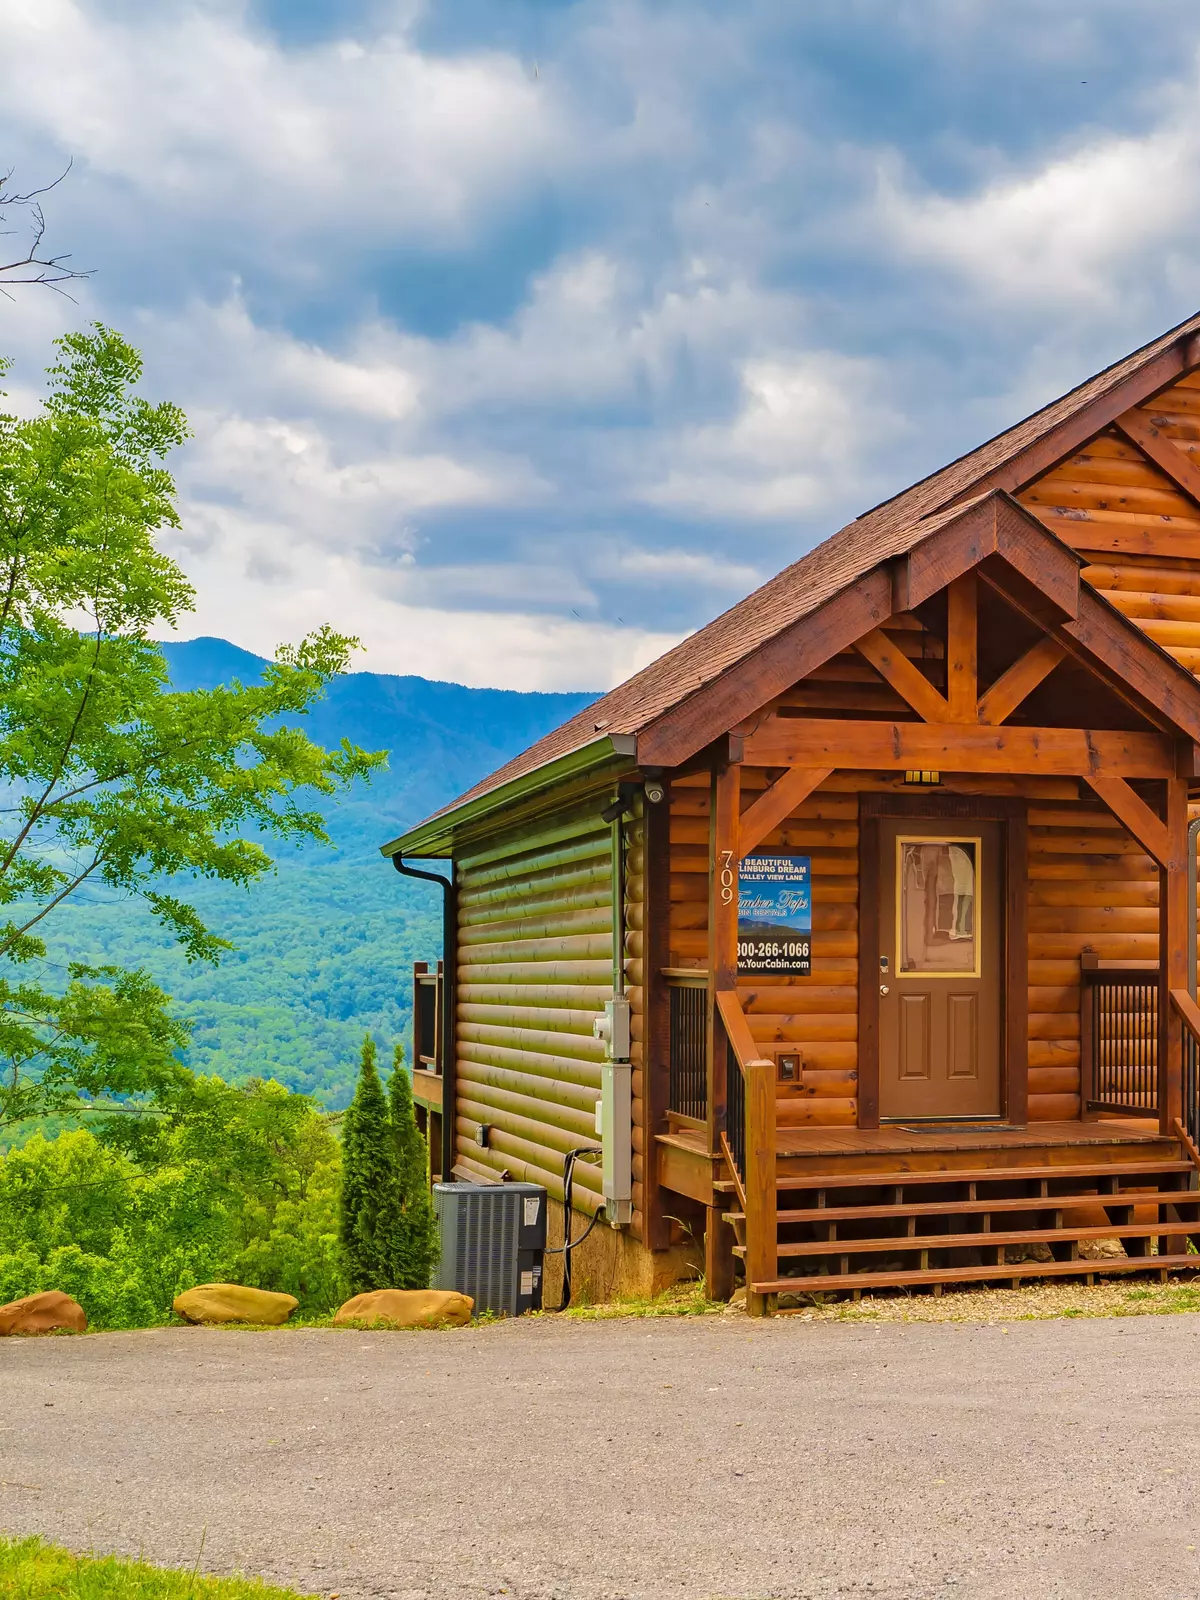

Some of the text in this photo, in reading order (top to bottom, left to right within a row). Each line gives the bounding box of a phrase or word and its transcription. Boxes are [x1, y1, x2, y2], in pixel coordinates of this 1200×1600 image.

[721, 850, 733, 905] 709
[752, 909, 788, 917] RENTALS
[776, 889, 809, 915] Tops
